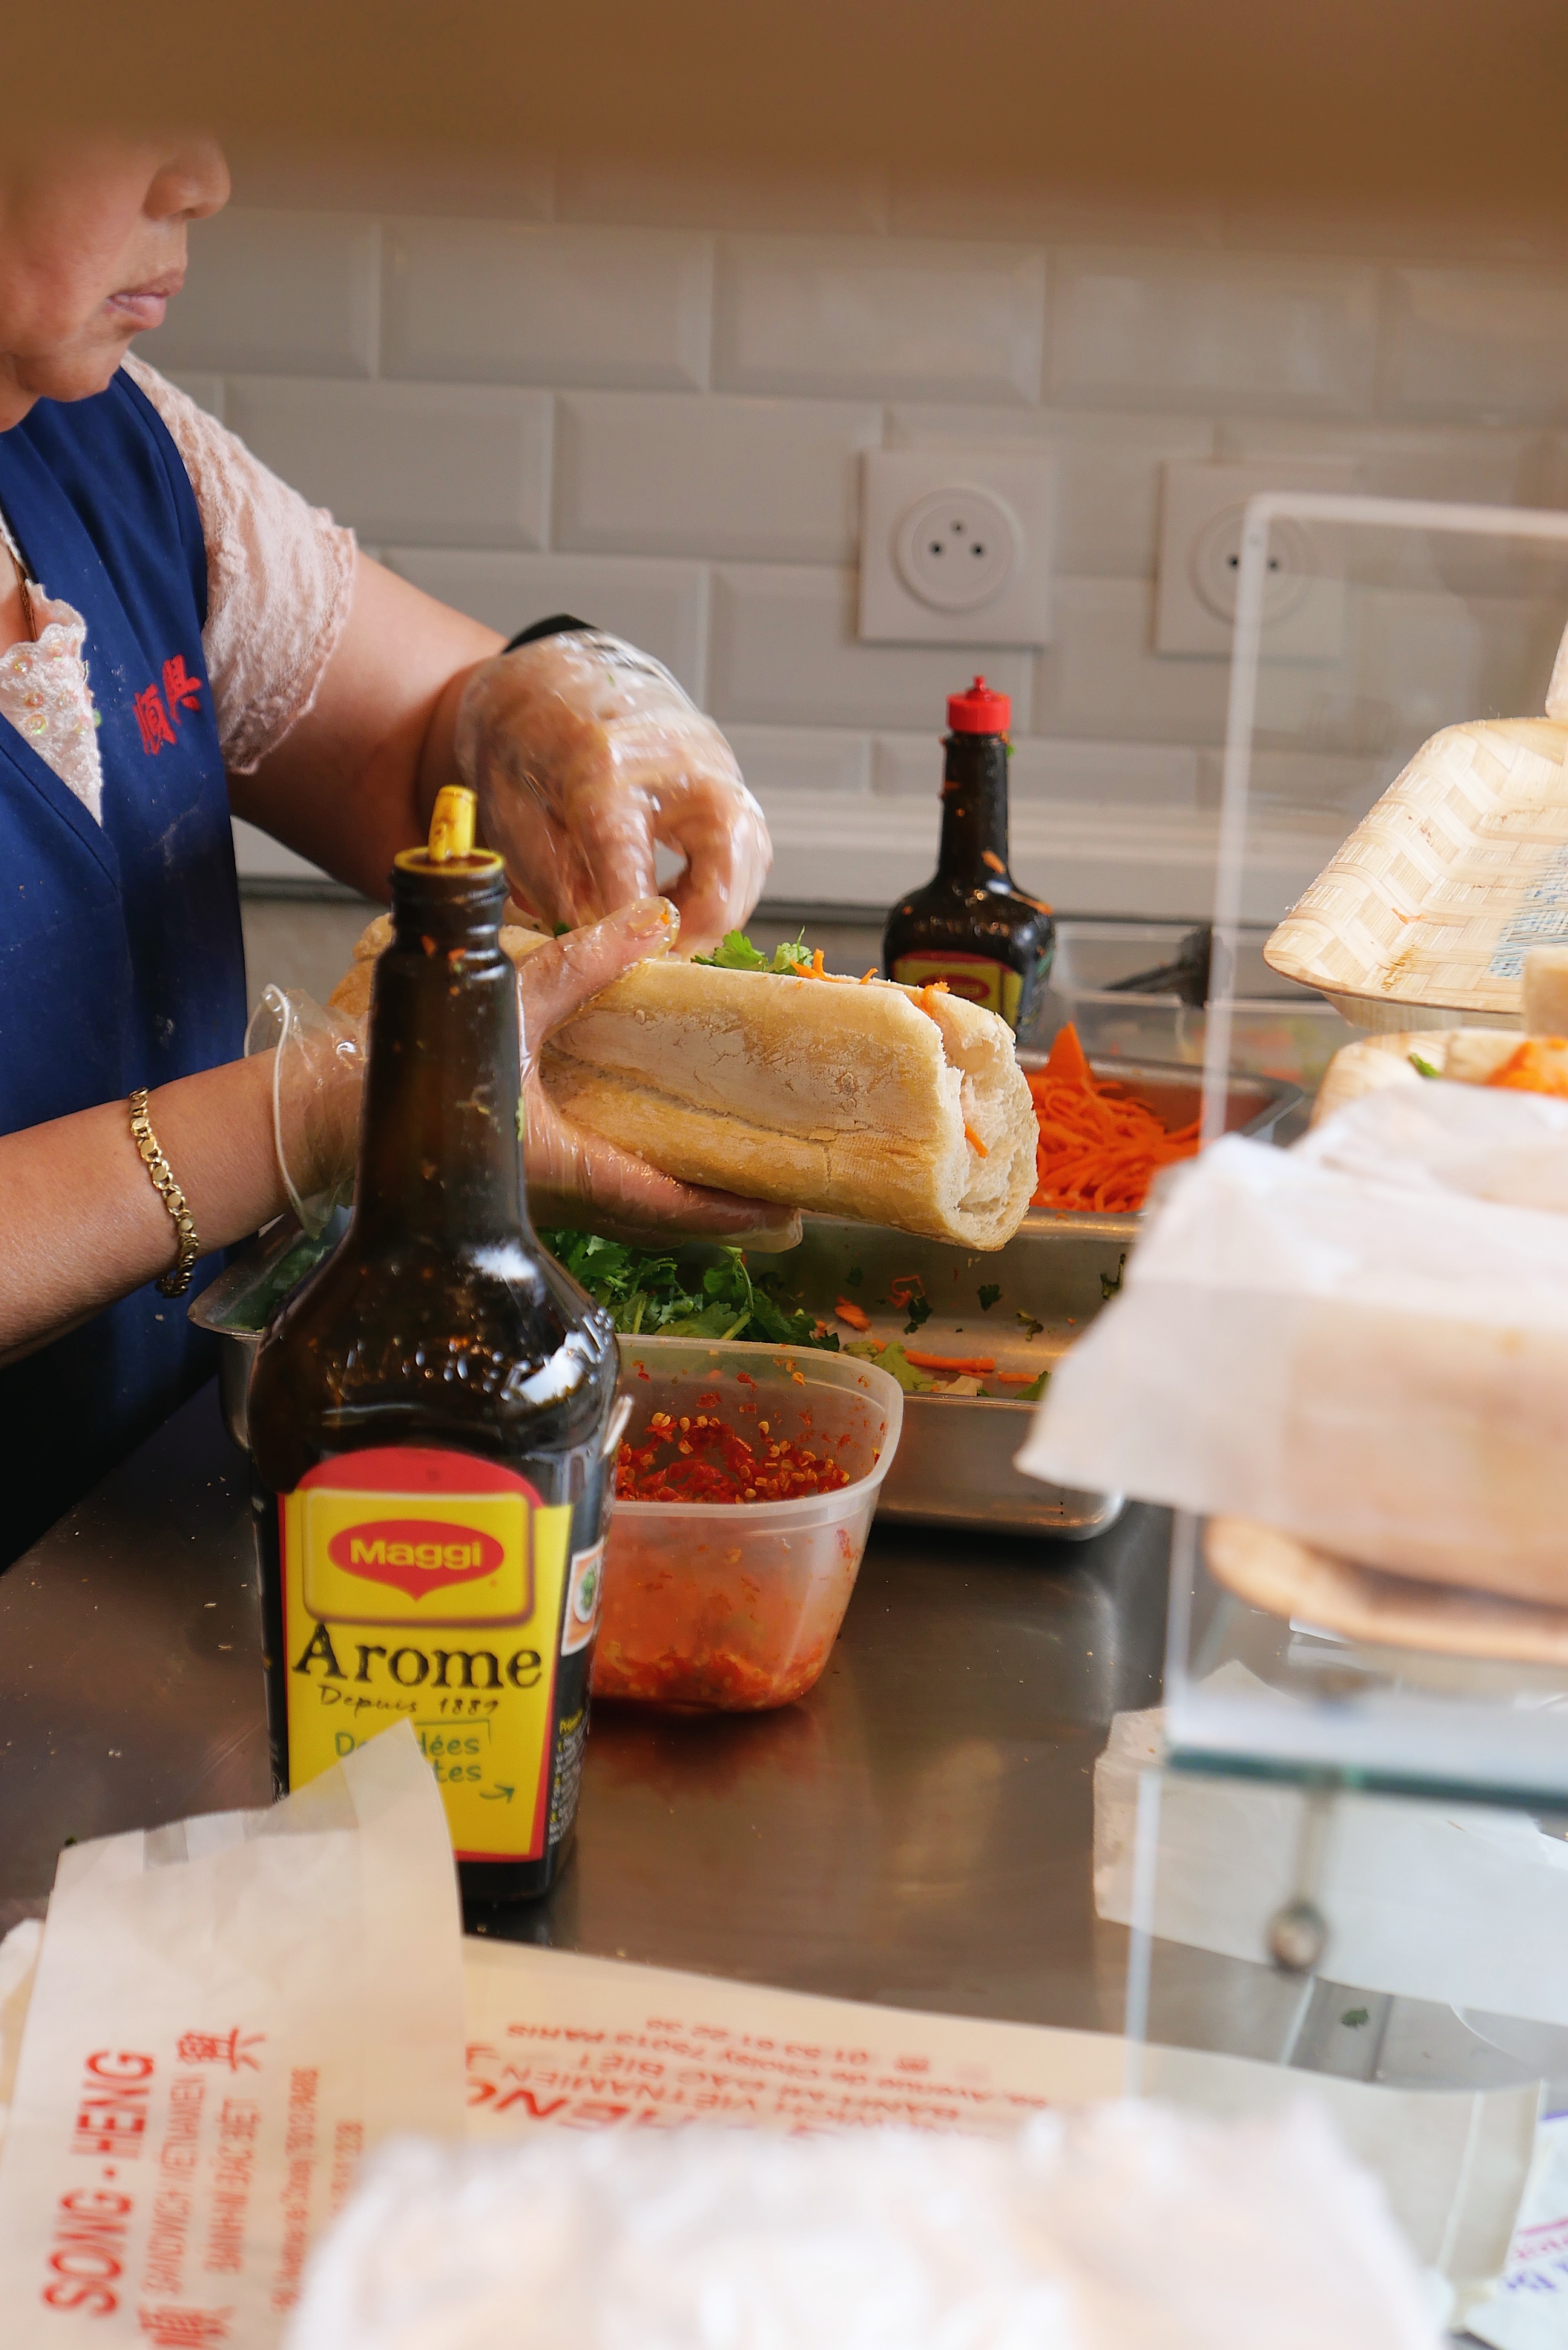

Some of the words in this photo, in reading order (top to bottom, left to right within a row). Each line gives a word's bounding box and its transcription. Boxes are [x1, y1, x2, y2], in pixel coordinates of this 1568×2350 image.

[350, 1539, 483, 1570] Maggi
[292, 1622, 543, 1690] Arome
[317, 1684, 417, 1718] Depuis
[440, 1697, 499, 1715] 1889
[506, 2024, 606, 2045] PARIS
[71, 2051, 155, 2159] HENG
[42, 2188, 132, 2319] SONG
